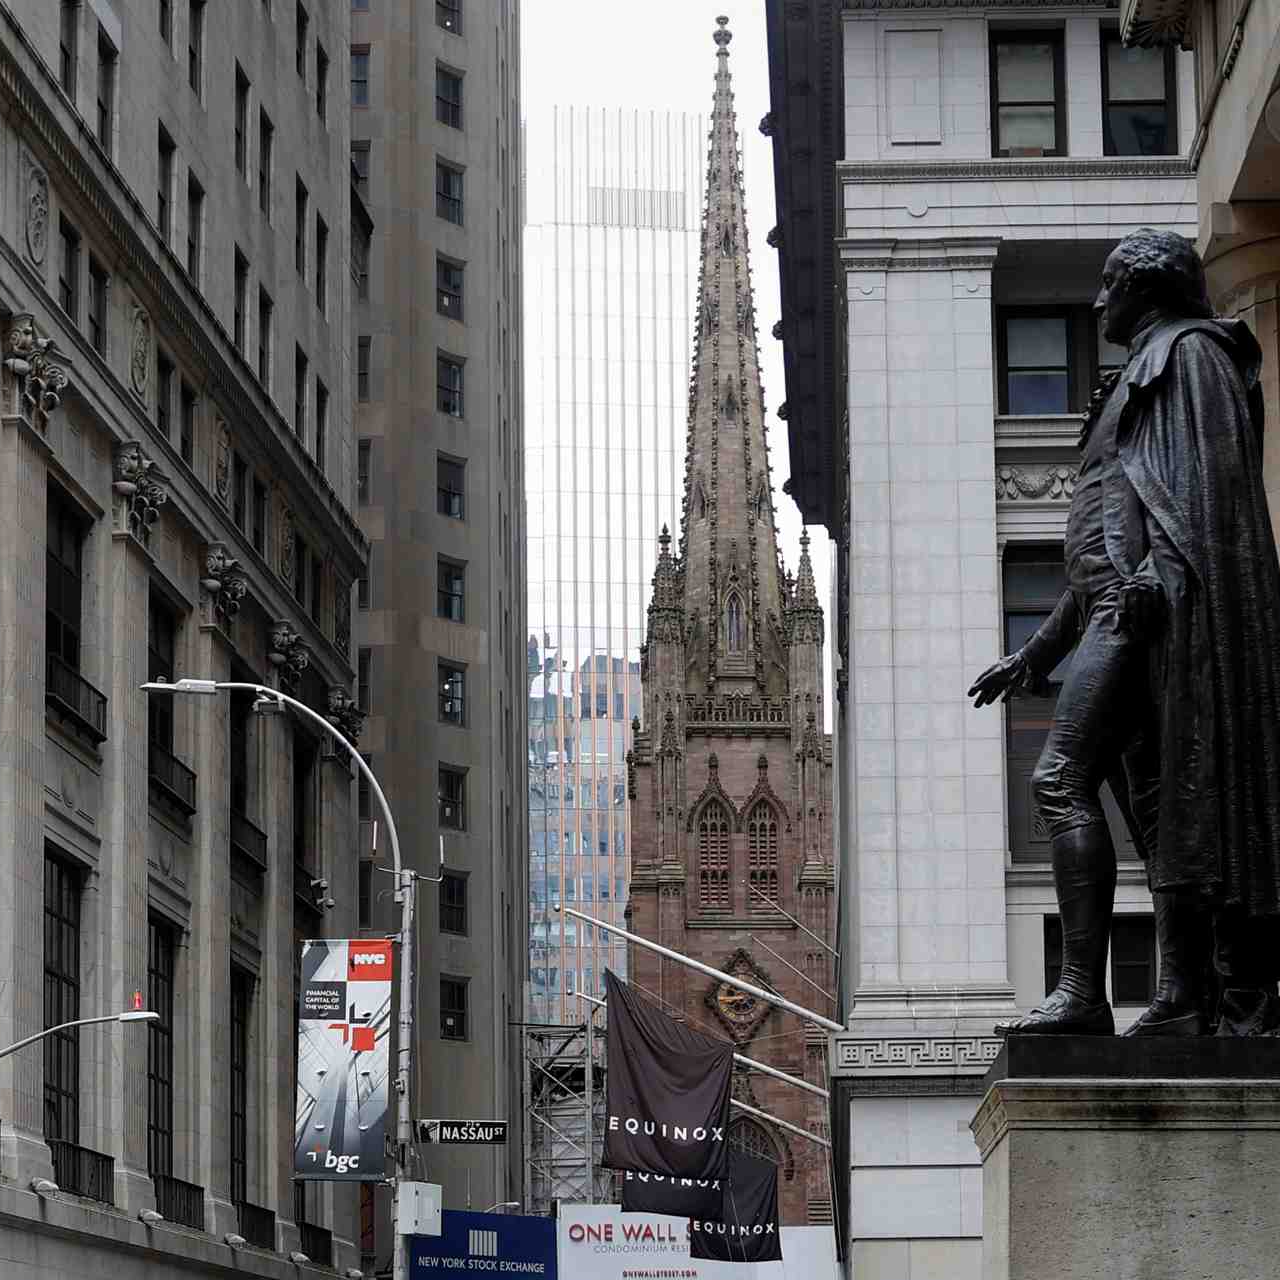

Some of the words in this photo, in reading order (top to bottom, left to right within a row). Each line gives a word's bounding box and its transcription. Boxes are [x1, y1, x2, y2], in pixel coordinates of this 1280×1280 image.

[354, 953, 385, 965] NYC
[442, 1127, 493, 1140] NASSAU
[609, 1116, 724, 1141] EQUINOX
[325, 1150, 360, 1173] bgc
[569, 1223, 613, 1242] ONE
[622, 1223, 676, 1242] WALL
[693, 1220, 775, 1236] EQUINOX
[593, 1244, 667, 1253] CONDOMINIUM
[418, 1256, 438, 1267] NEW
[441, 1258, 466, 1269] YORK
[468, 1260, 498, 1271] STOCK
[499, 1261, 544, 1273] EXCHANGE
